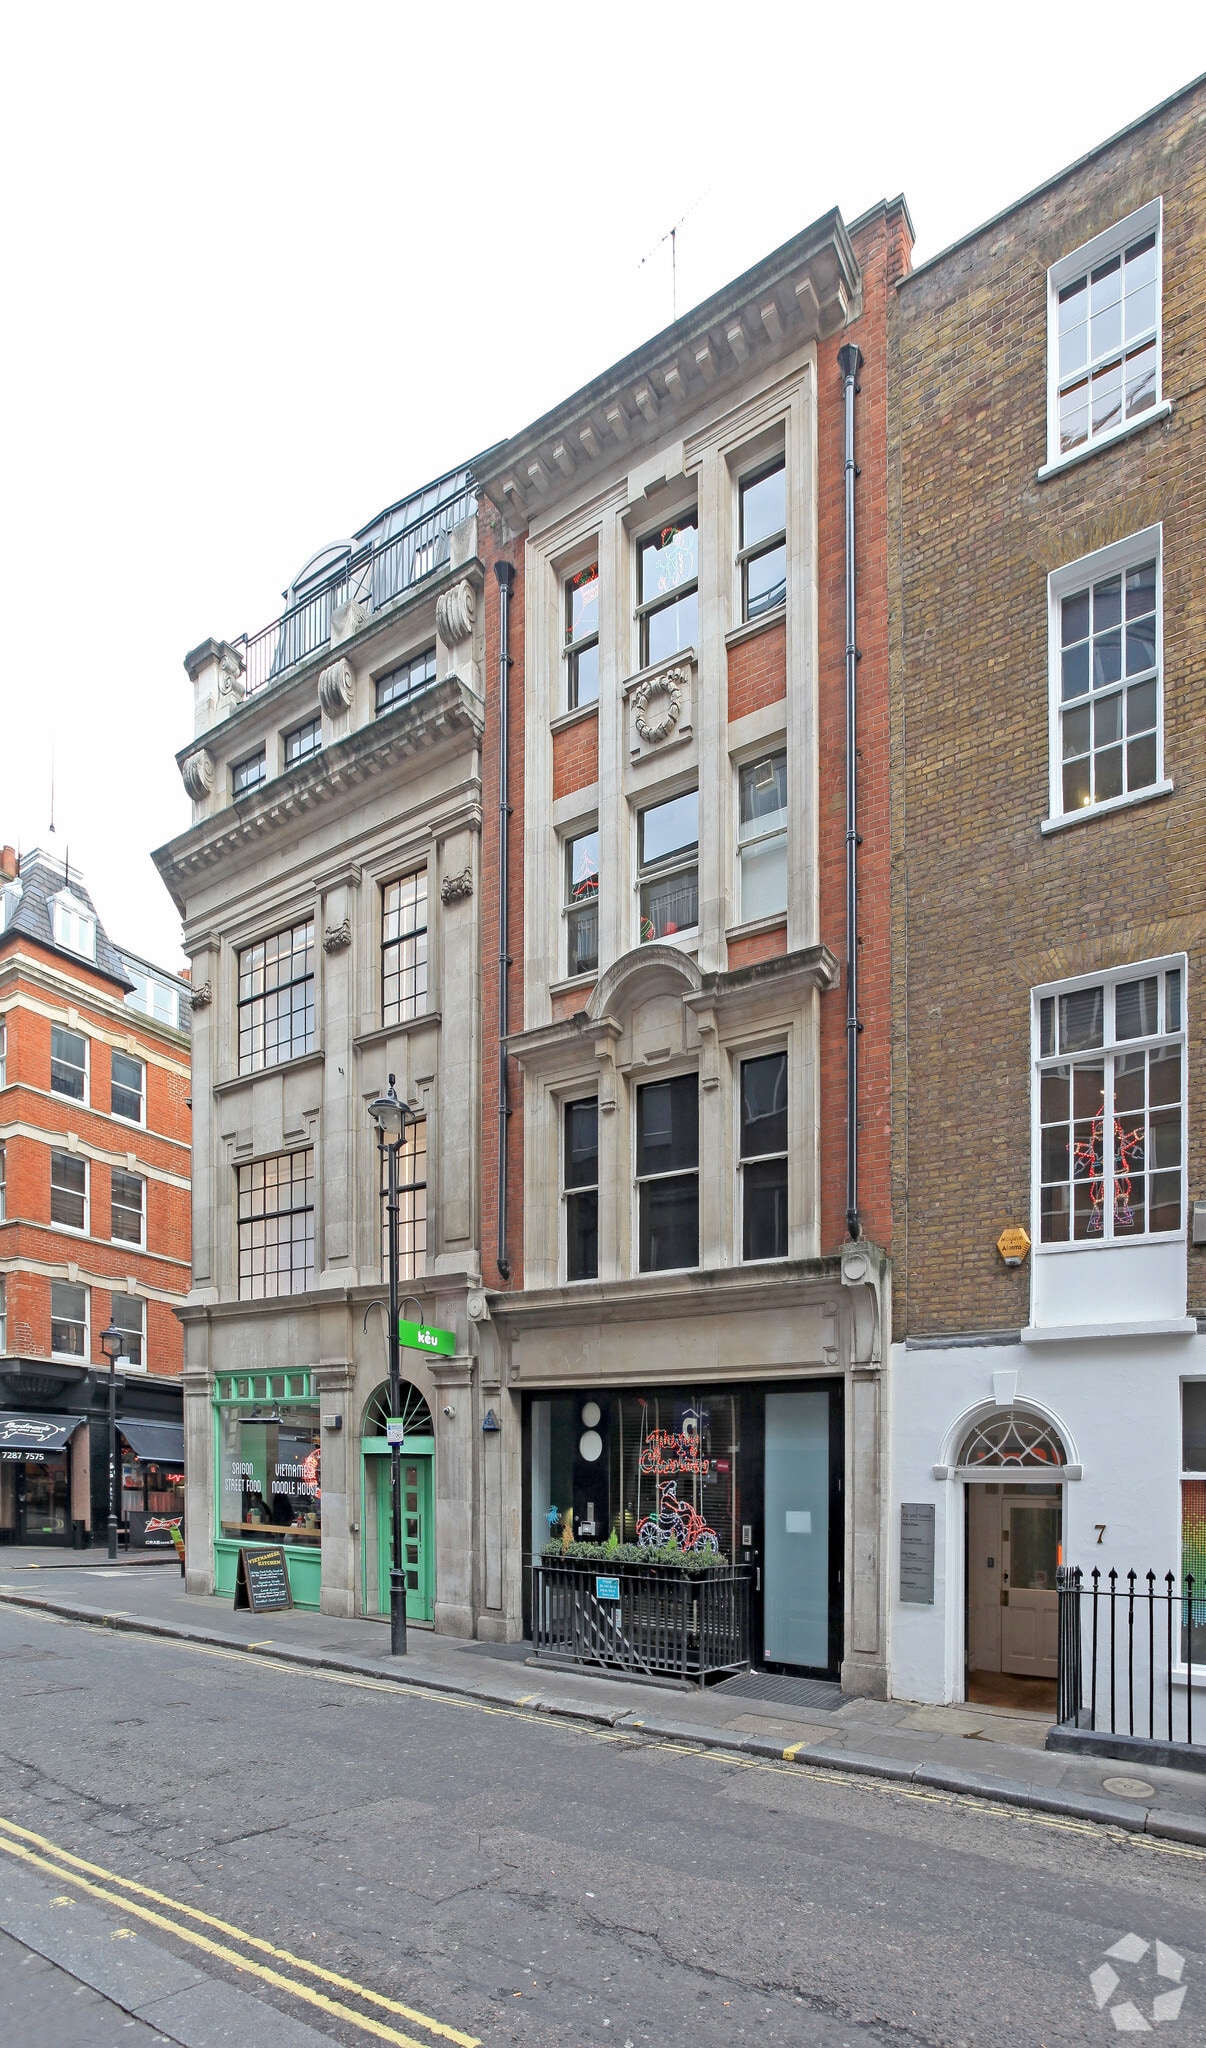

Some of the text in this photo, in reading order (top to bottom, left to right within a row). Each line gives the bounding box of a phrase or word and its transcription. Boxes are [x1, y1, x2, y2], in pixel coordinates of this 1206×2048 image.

[417, 1330, 438, 1346] kêu
[2, 1451, 44, 1460] 7287 7575
[231, 1462, 254, 1475] SAIGON
[224, 1478, 262, 1492] STREET FOOD
[271, 1480, 295, 1495] NOODLE
[1094, 1524, 1106, 1543] 7
